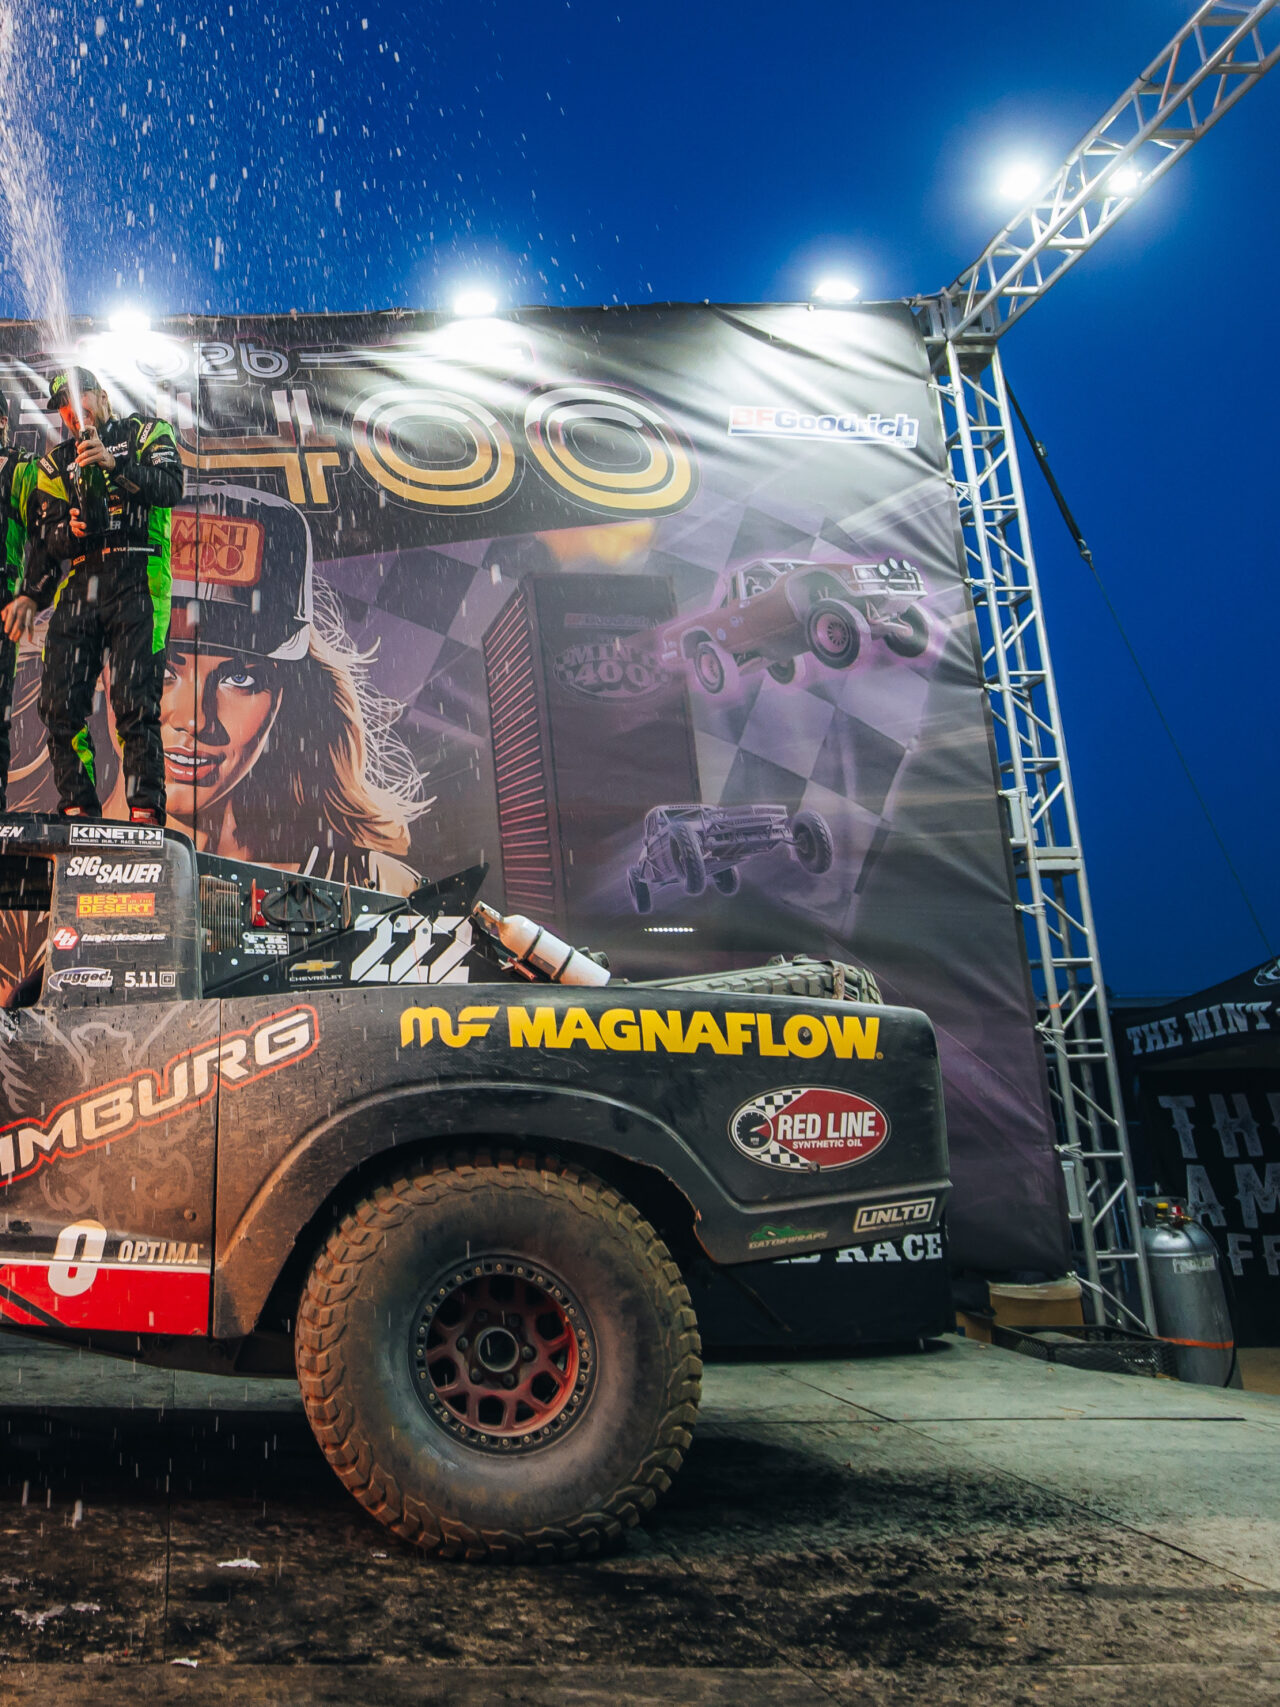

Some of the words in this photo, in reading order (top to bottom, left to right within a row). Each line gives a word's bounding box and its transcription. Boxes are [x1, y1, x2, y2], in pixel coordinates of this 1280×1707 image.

[732, 408, 915, 437] BFGoodrich
[156, 382, 698, 510] 400
[66, 855, 102, 877] SIG
[95, 863, 162, 884] SAUER
[79, 894, 132, 904] BEST
[79, 903, 153, 914] DESERT
[350, 914, 474, 984] 222
[124, 971, 158, 988] 5.11
[289, 974, 343, 982] CHEVROLET
[506, 1006, 881, 1060] MAGNAFLOW
[1126, 1017, 1183, 1055] THE
[1184, 1001, 1272, 1042] MINT
[777, 1112, 821, 1141] RED
[826, 1111, 877, 1139] LINE
[792, 1139, 845, 1150] SYNTHETIC
[847, 1138, 863, 1148] OIL
[860, 1203, 929, 1227] UNLTD
[117, 1239, 199, 1264] OPTIMA
